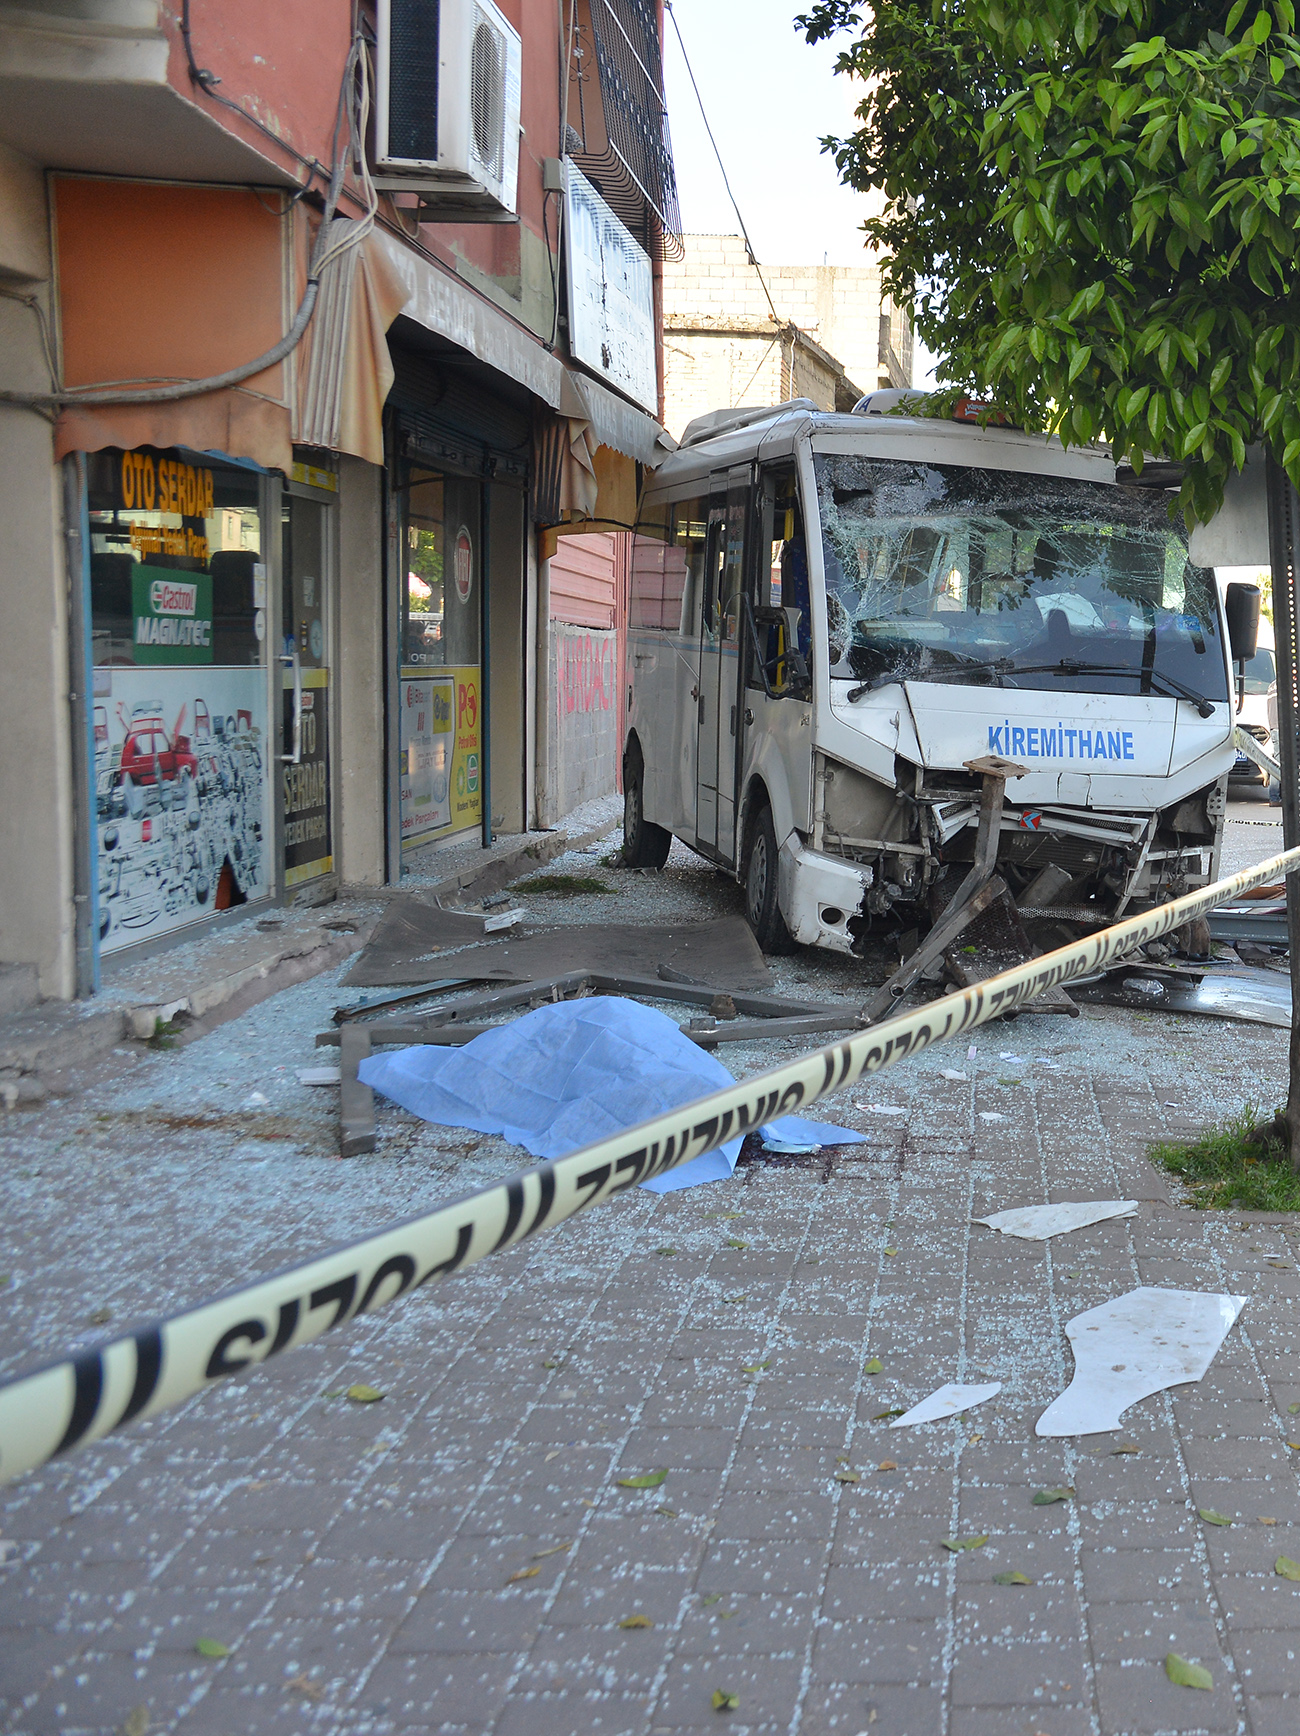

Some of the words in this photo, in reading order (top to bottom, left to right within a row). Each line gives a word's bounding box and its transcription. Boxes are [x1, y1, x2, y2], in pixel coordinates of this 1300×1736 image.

[121, 450, 156, 511] OTO
[158, 458, 215, 519] SERDAR
[162, 585, 194, 611] Castrol
[136, 616, 212, 647] MAGNATEC
[988, 719, 1135, 760] KİREMİTHANE
[283, 760, 327, 815] SERDAR
